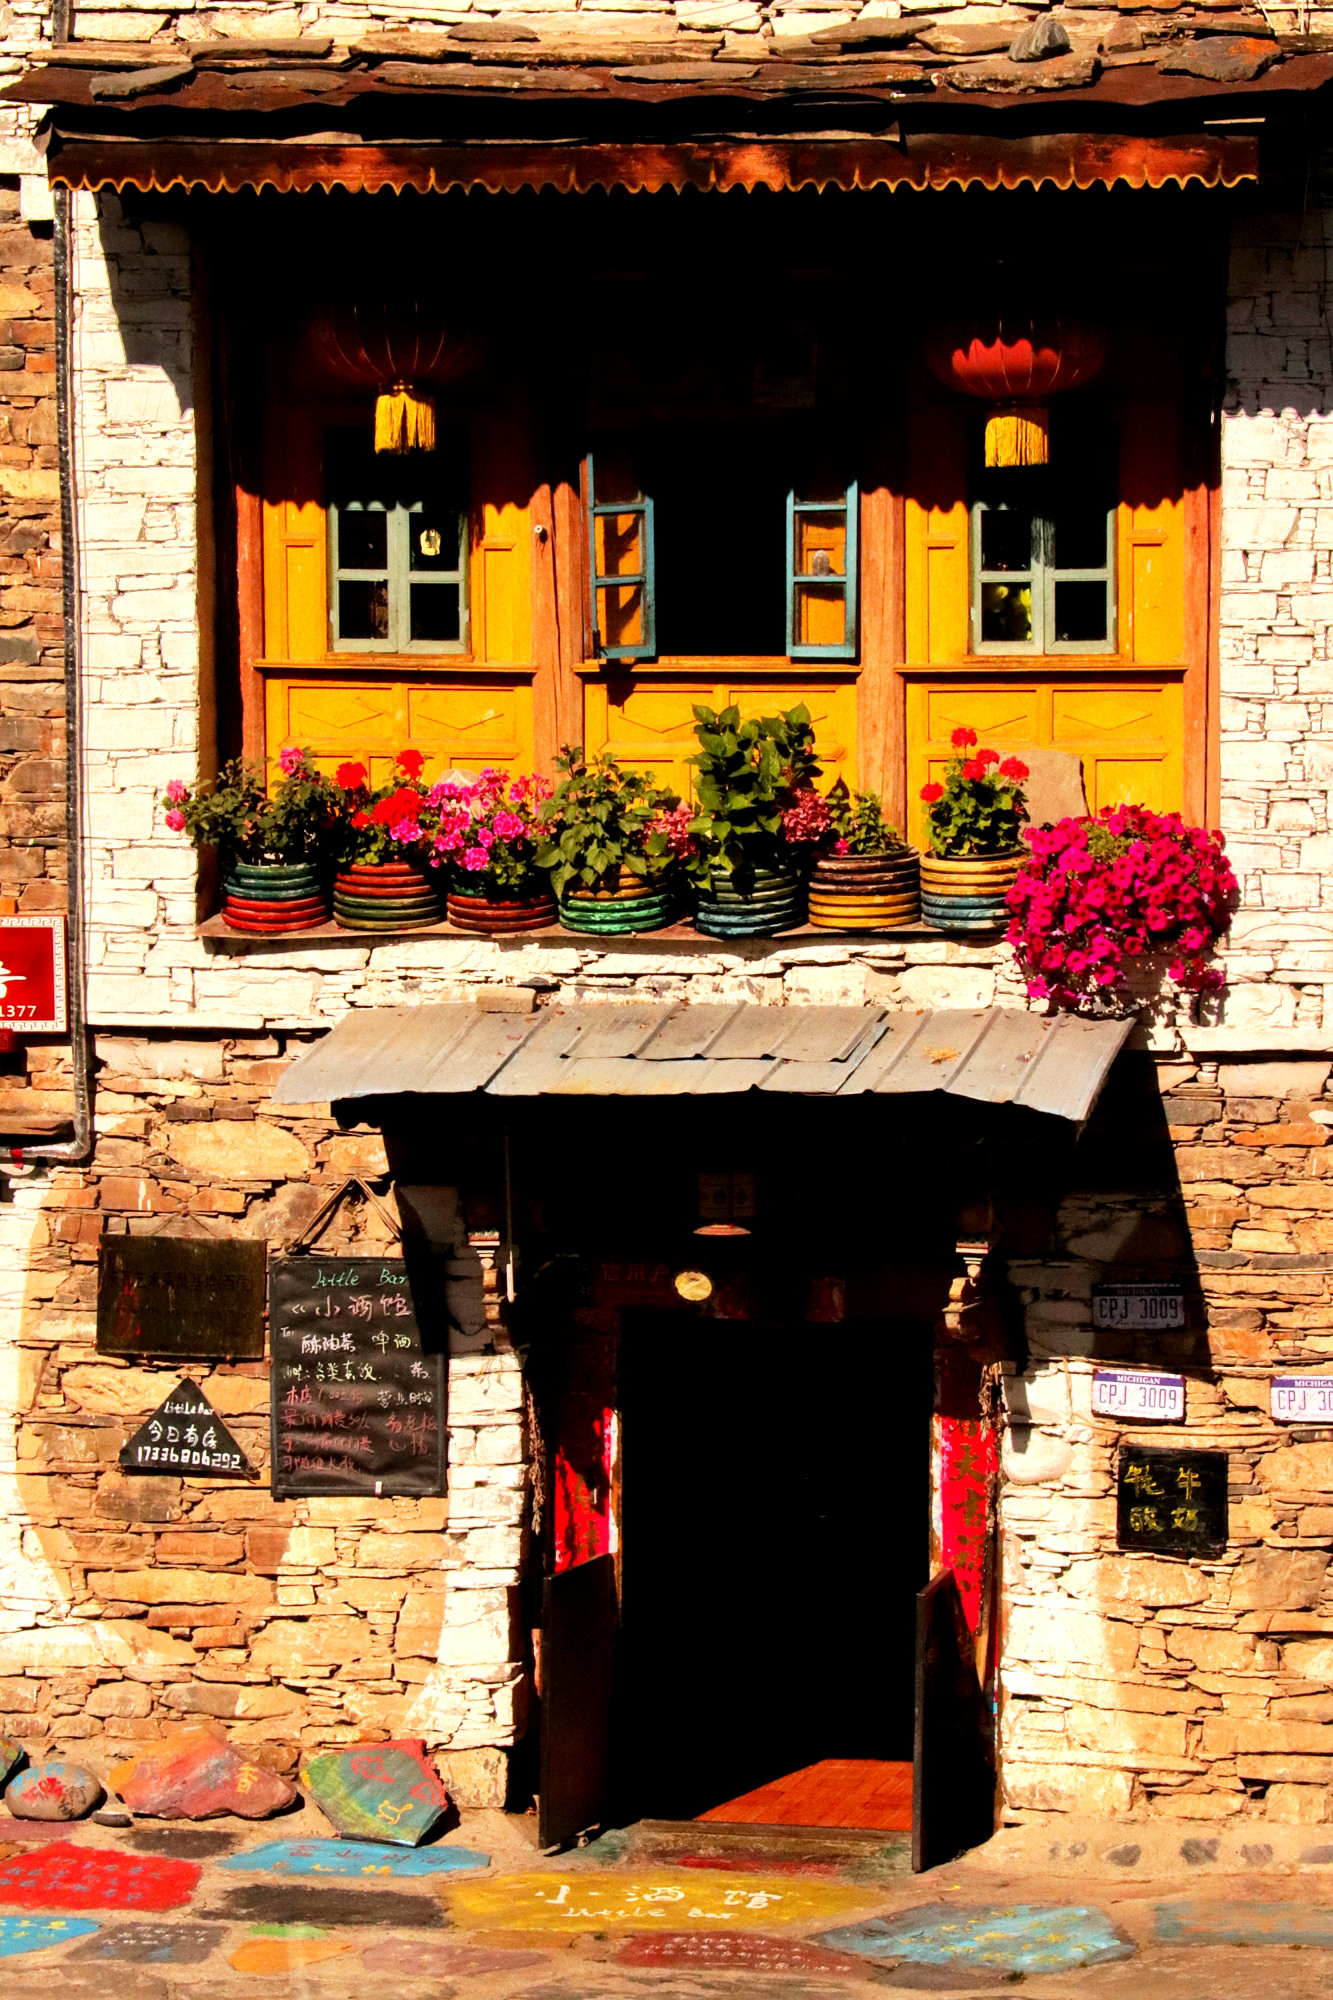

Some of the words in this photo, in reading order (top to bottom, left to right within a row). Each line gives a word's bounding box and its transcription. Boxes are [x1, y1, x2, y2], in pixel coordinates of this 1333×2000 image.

[1116, 1287, 1161, 1296] MICHIGAN
[1099, 1297, 1128, 1319] CPJ
[1139, 1297, 1179, 1320] 3009
[1116, 1375, 1161, 1386] MICHIGAN
[1294, 1379, 1333, 1388] MICHIGA
[1099, 1384, 1127, 1406] CPJ
[1138, 1387, 1178, 1409] 3009
[1278, 1389, 1307, 1411] CPJ
